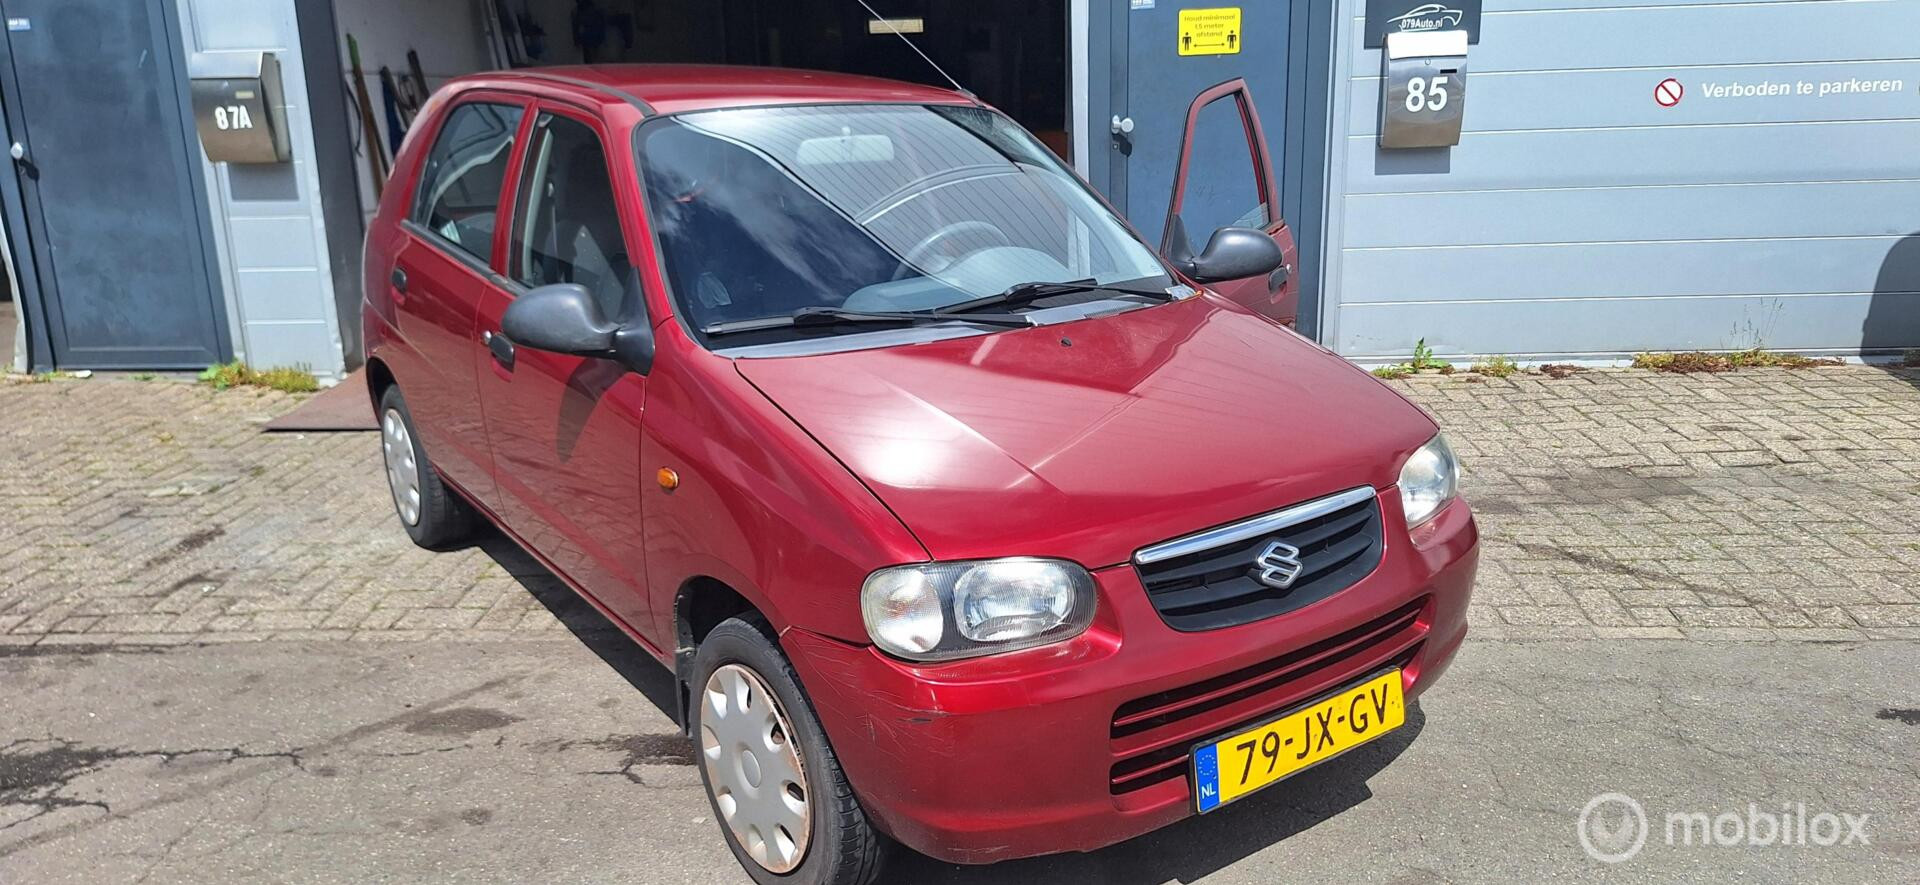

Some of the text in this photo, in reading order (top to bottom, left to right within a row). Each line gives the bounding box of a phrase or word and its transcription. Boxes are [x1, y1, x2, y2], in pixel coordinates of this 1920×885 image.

[1401, 18, 1443, 29] 079Auto.nl
[1405, 76, 1448, 113] 85
[1702, 77, 1903, 98] Verboden te parkeren
[214, 105, 254, 130] 87A
[1236, 683, 1388, 786] 79-JX-GV
[1201, 783, 1217, 799] NL
